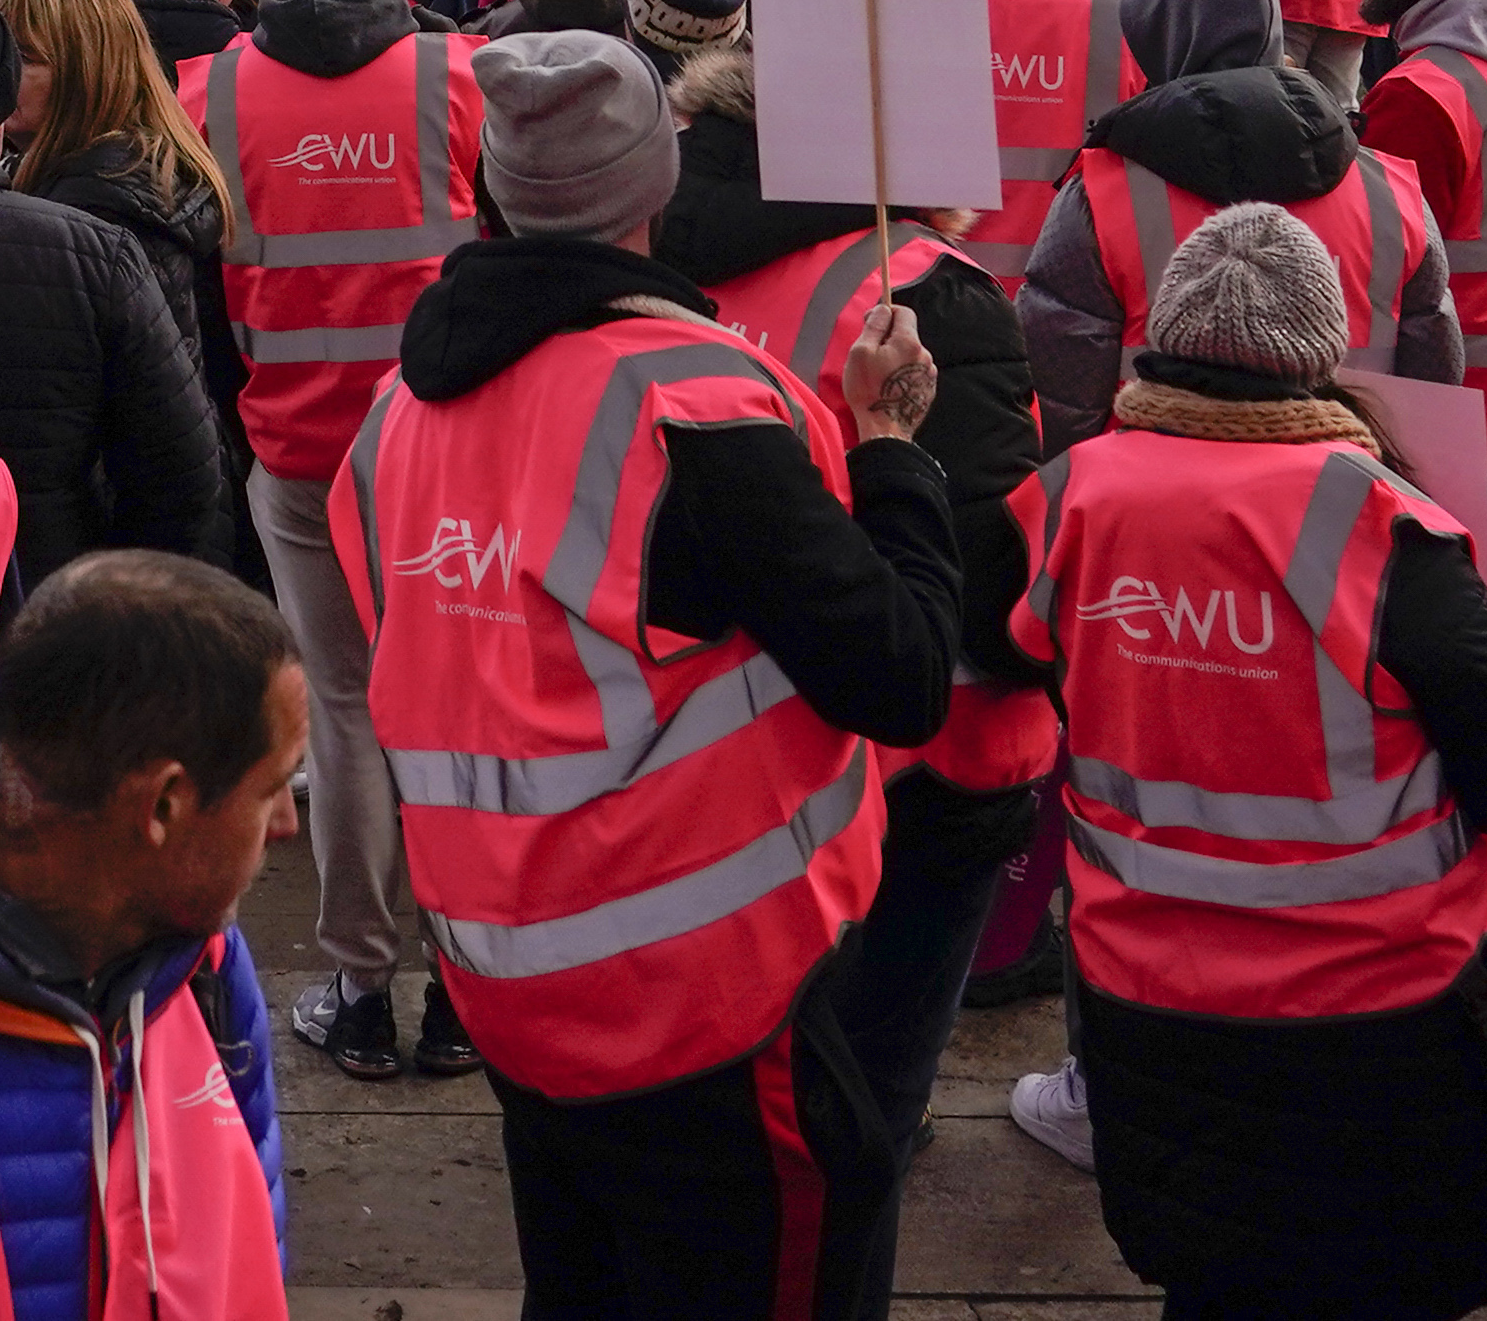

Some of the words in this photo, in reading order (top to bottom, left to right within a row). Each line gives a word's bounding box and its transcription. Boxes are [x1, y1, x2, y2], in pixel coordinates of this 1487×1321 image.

[991, 53, 1064, 90] WU
[266, 133, 395, 171] CWU
[299, 177, 311, 185] The
[313, 176, 372, 185] communications
[374, 176, 396, 184] union
[393, 517, 521, 595] CW
[1077, 575, 1274, 654] CWU
[1116, 644, 1133, 659] The
[1135, 654, 1236, 676] communications
[1239, 667, 1278, 680] union
